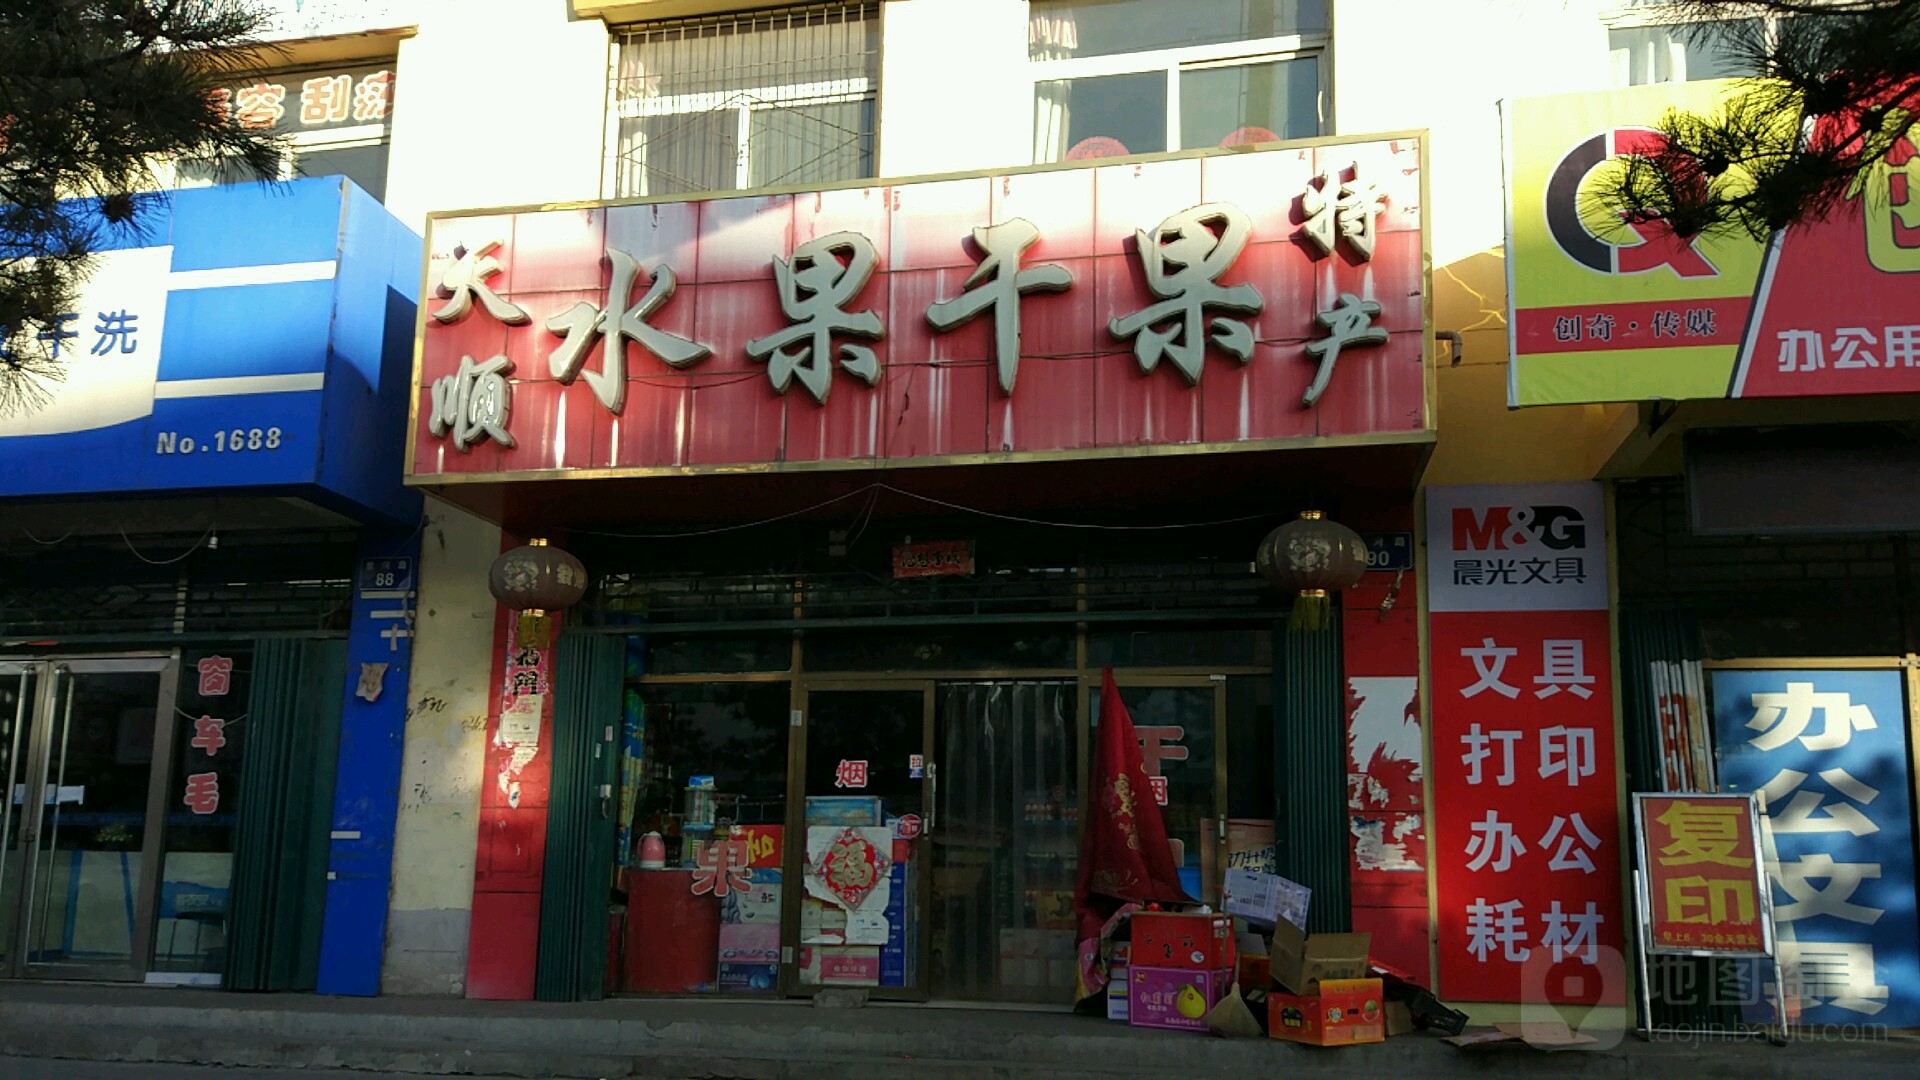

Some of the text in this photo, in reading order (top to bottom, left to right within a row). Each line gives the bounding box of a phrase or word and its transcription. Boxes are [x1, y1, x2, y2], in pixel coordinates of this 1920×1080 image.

[545, 203, 1263, 415] 水果干果
[1299, 160, 1389, 405] 特产
[428, 240, 531, 452] 天顺
[1776, 325, 1920, 372] 办公用
[156, 427, 282, 456] No.1688
[1452, 506, 1586, 551] M&G
[375, 571, 395, 587] 88
[1453, 558, 1587, 585] 晨光文具
[1459, 637, 1597, 701] 文具
[834, 758, 868, 789] 烟
[1460, 723, 1596, 787] 打印
[690, 840, 753, 898] 果
[827, 839, 876, 889] 福
[1464, 810, 1602, 875] 办公
[1655, 799, 1757, 926] 复印
[1744, 681, 1889, 1015] 办公文具
[1466, 897, 1605, 967] 耗材
